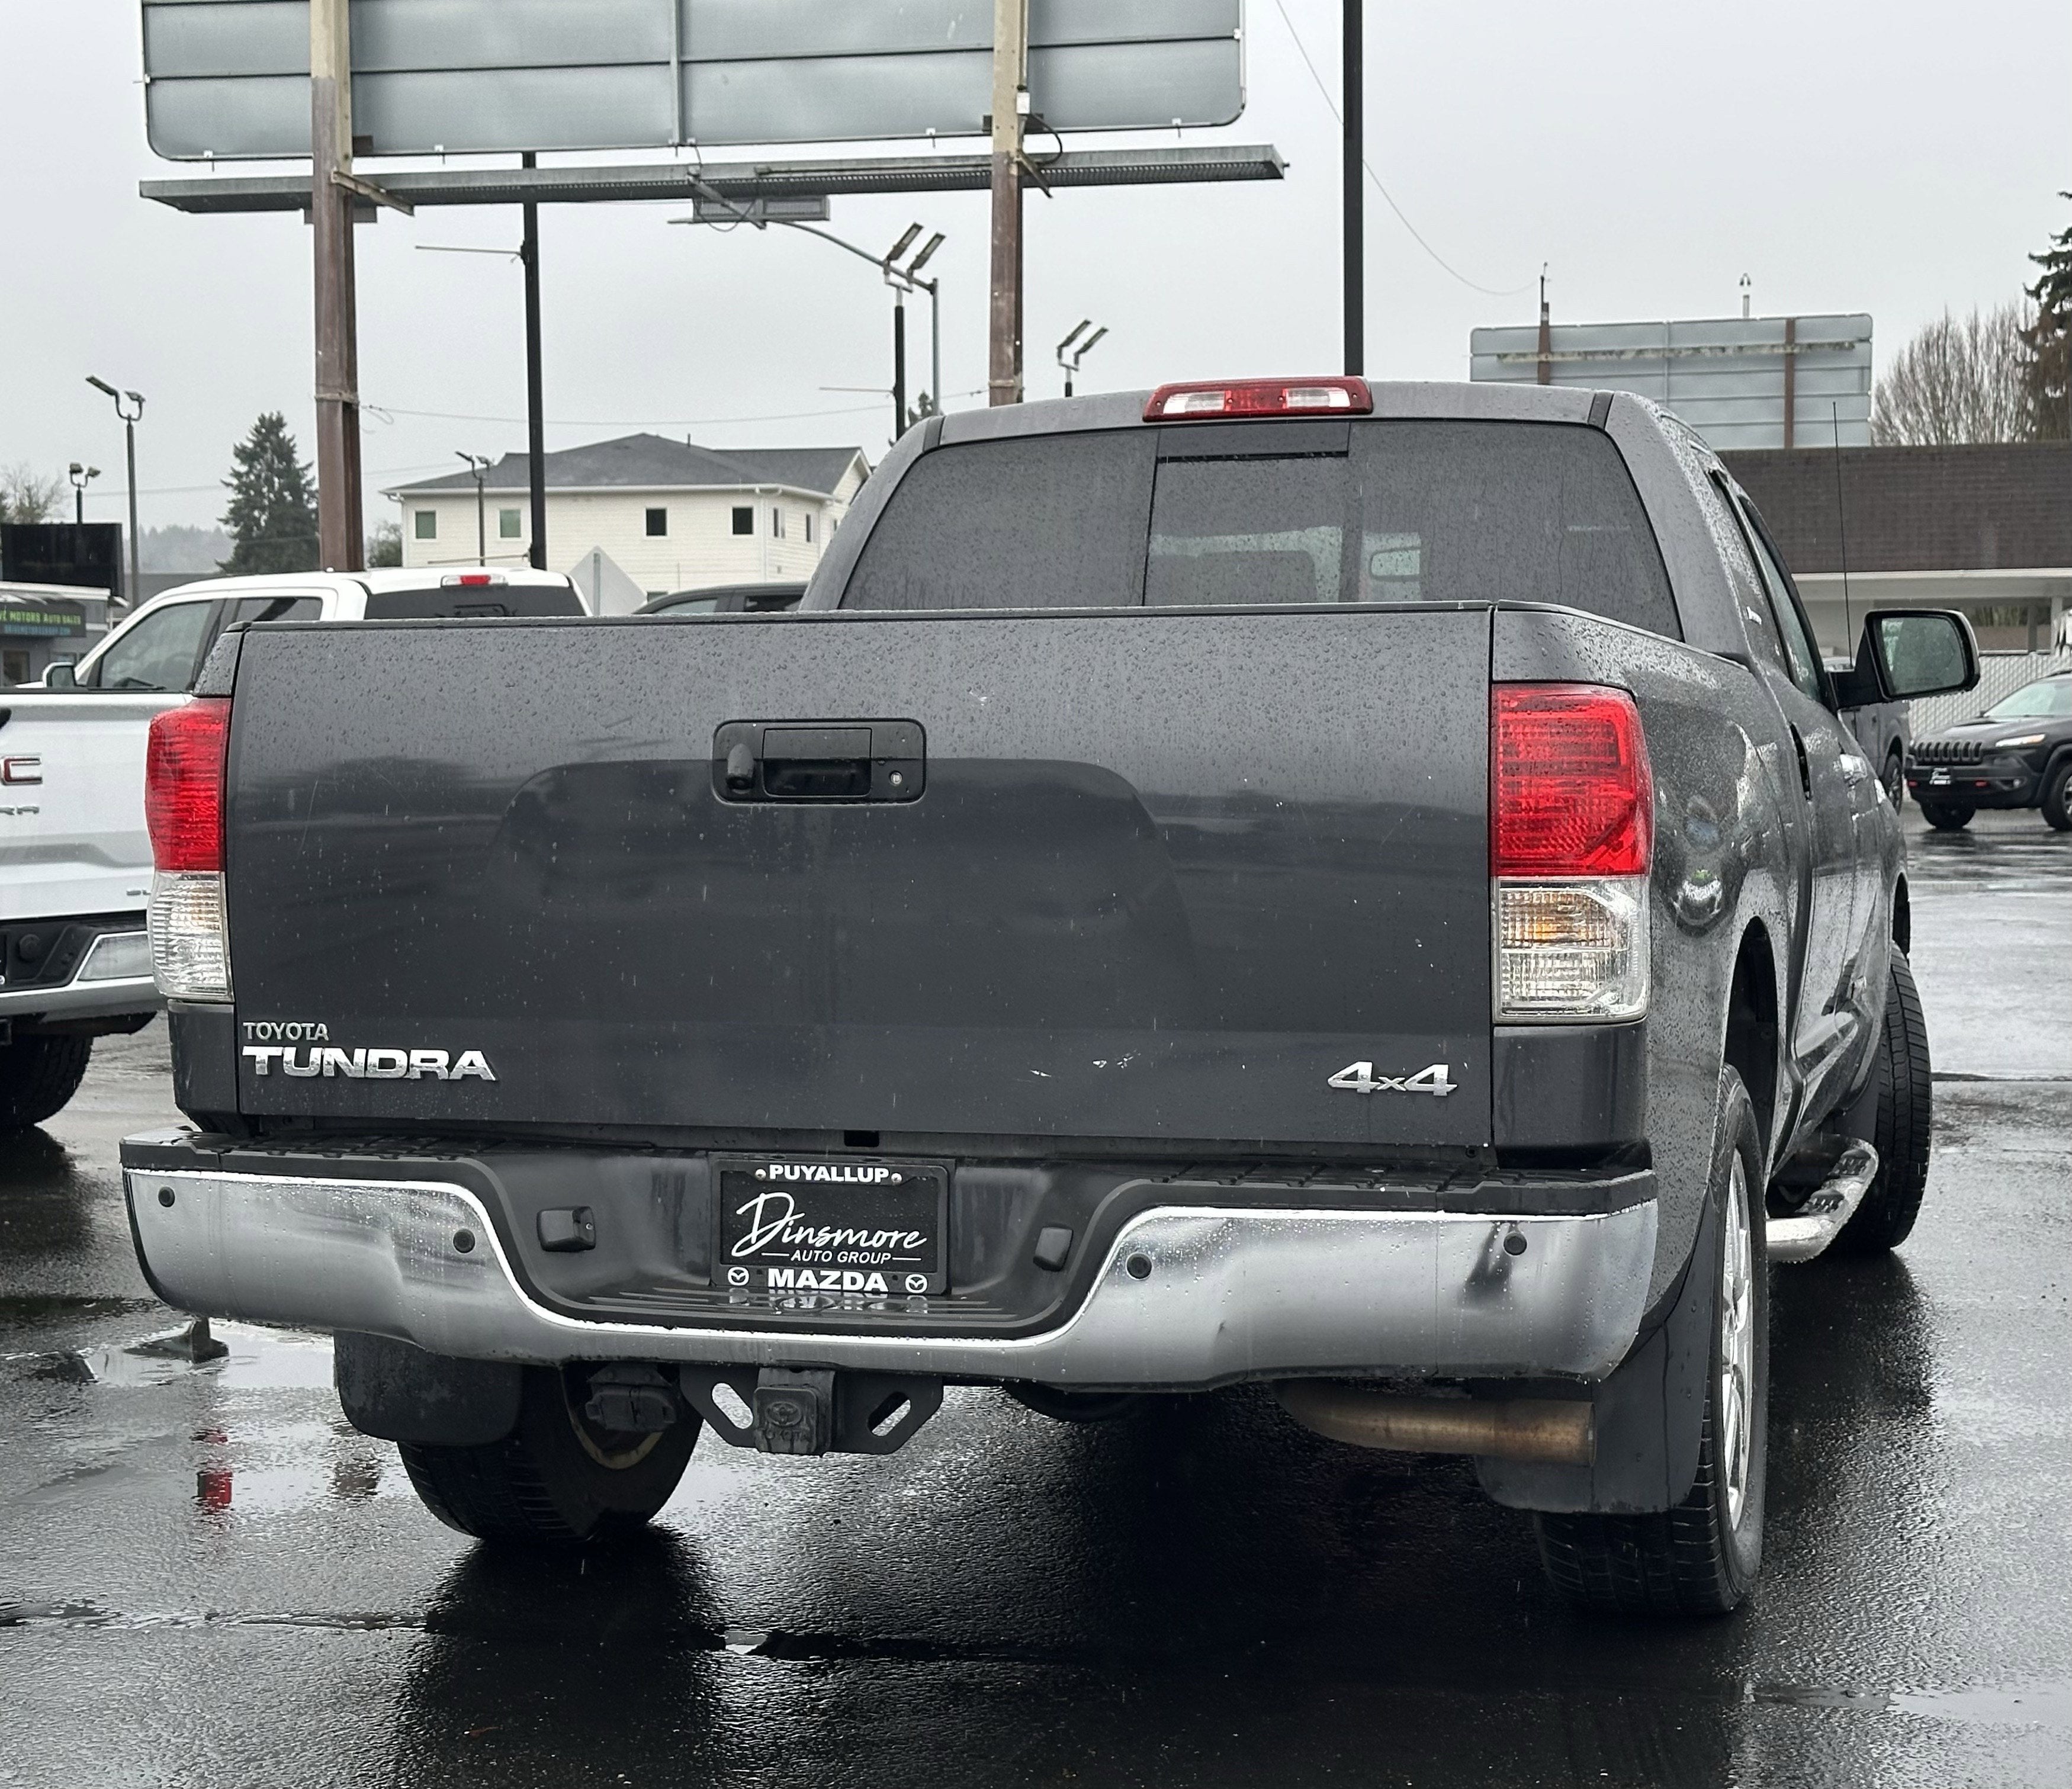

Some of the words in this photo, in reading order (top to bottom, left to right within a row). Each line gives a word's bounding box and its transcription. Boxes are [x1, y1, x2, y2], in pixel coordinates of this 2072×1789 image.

[9, 611, 40, 624] MOTORS
[243, 1022, 329, 1041] TOYOTA
[242, 1045, 496, 1081] TUNDRA
[1327, 1061, 1458, 1096] 4x4
[769, 1164, 889, 1183] PUYALLUP
[731, 1192, 927, 1257] Dinsmore
[791, 1250, 831, 1263] AUTO
[837, 1251, 891, 1264] GROUP
[768, 1268, 889, 1293] MAZDA
